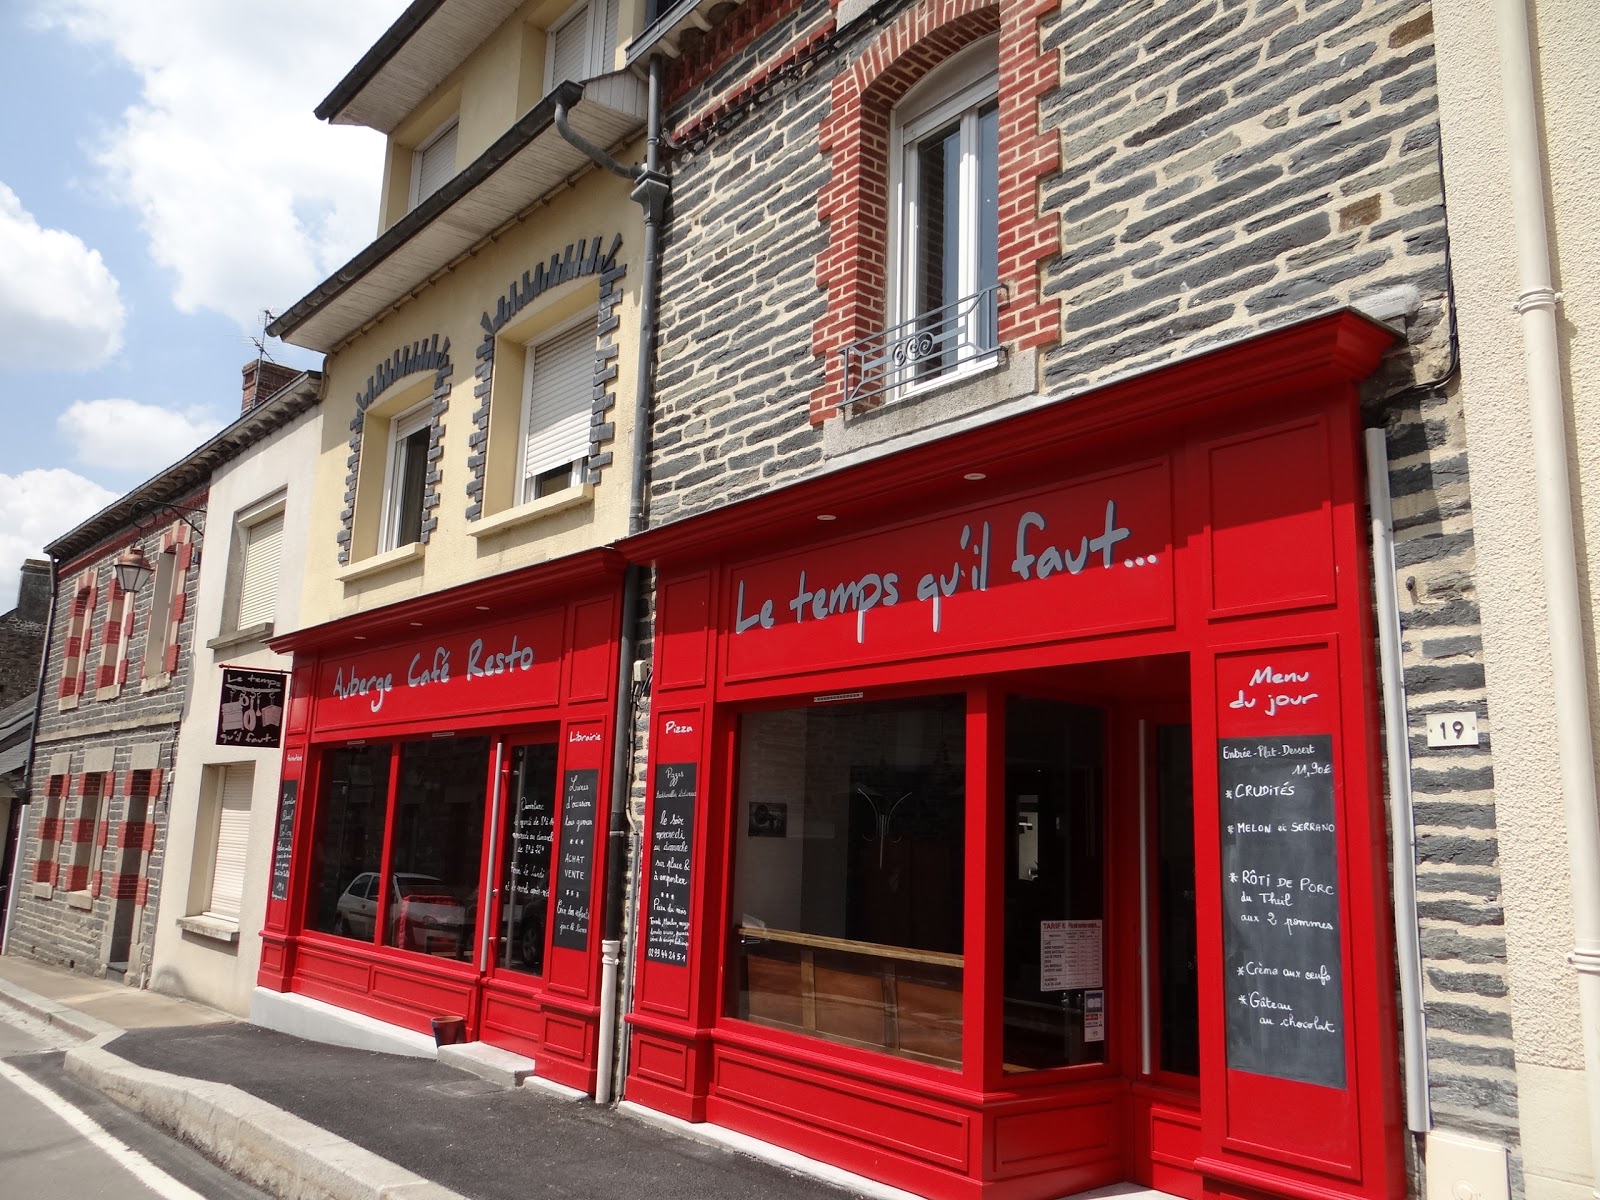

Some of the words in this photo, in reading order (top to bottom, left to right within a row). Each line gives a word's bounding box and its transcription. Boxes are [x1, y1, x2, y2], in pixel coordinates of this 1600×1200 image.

[735, 580, 774, 634] Le
[790, 571, 898, 643] temps
[917, 521, 990, 632] qu'il
[227, 674, 243, 683] Le
[247, 674, 281, 688] temps
[333, 665, 393, 713] Auberge
[408, 646, 450, 688] Café
[466, 635, 533, 682] Resto
[1249, 666, 1310, 686] Menu
[1229, 689, 1256, 708] du
[1264, 692, 1319, 716] jour
[665, 720, 693, 734] Pizza
[1440, 720, 1464, 740] 19
[569, 731, 601, 742] Librairie
[1237, 822, 1271, 833] MELON
[1291, 821, 1335, 833] SERRANO
[564, 852, 585, 863] ACHAT
[564, 869, 585, 880] VENTE
[1277, 877, 1293, 887] DE
[1300, 877, 1334, 895] PORC
[1240, 891, 1252, 903] du
[1240, 914, 1260, 922] aux
[1267, 912, 1277, 925] 2
[1284, 916, 1333, 935] pommes
[1246, 961, 1278, 975] Crème
[1282, 967, 1301, 978] aux
[1249, 991, 1293, 1011] Gâteau
[1259, 1016, 1274, 1025] au
[1280, 1014, 1335, 1033] chocolat
